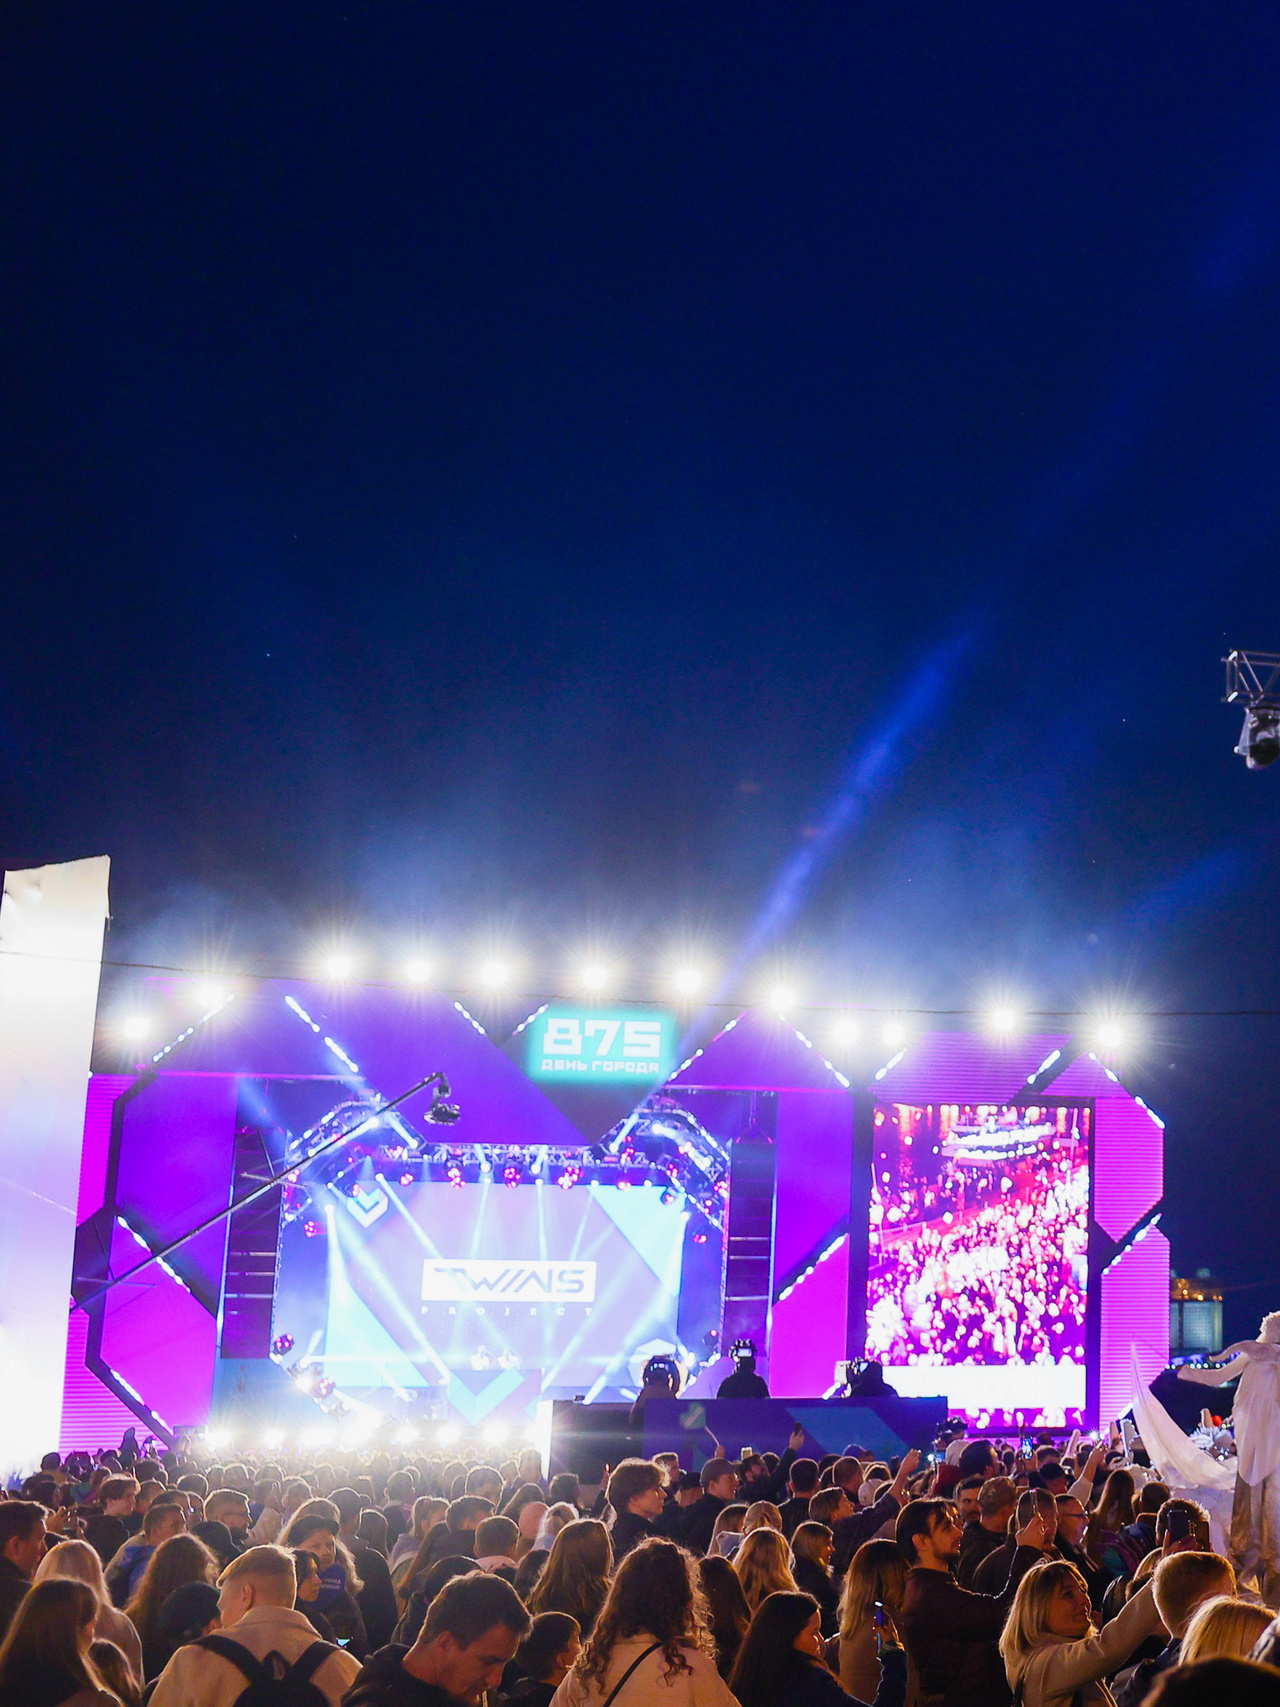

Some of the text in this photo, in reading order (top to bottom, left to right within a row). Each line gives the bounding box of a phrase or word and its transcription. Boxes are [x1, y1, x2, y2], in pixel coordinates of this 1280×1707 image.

[543, 1018, 661, 1058] 875
[541, 1059, 660, 1074] ДЕНЬ ГОРОДА
[433, 1267, 586, 1293] TWINS
